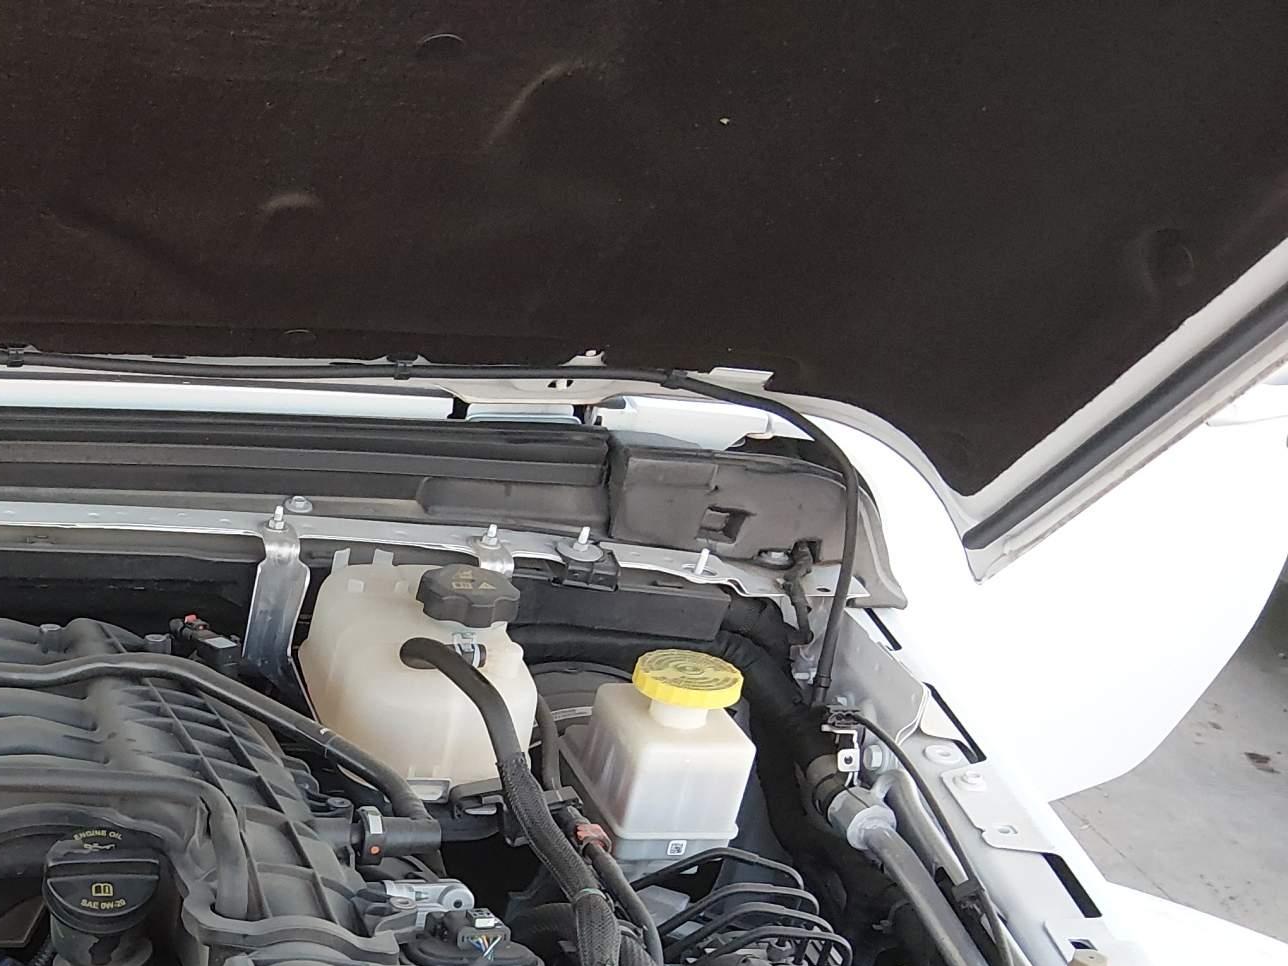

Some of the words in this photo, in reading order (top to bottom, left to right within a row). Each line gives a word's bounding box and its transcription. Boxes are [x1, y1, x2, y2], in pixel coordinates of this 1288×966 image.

[73, 829, 108, 841] ENGINE
[109, 830, 123, 841] OIL
[80, 899, 99, 910] SAE
[100, 899, 127, 910] 0W-20
